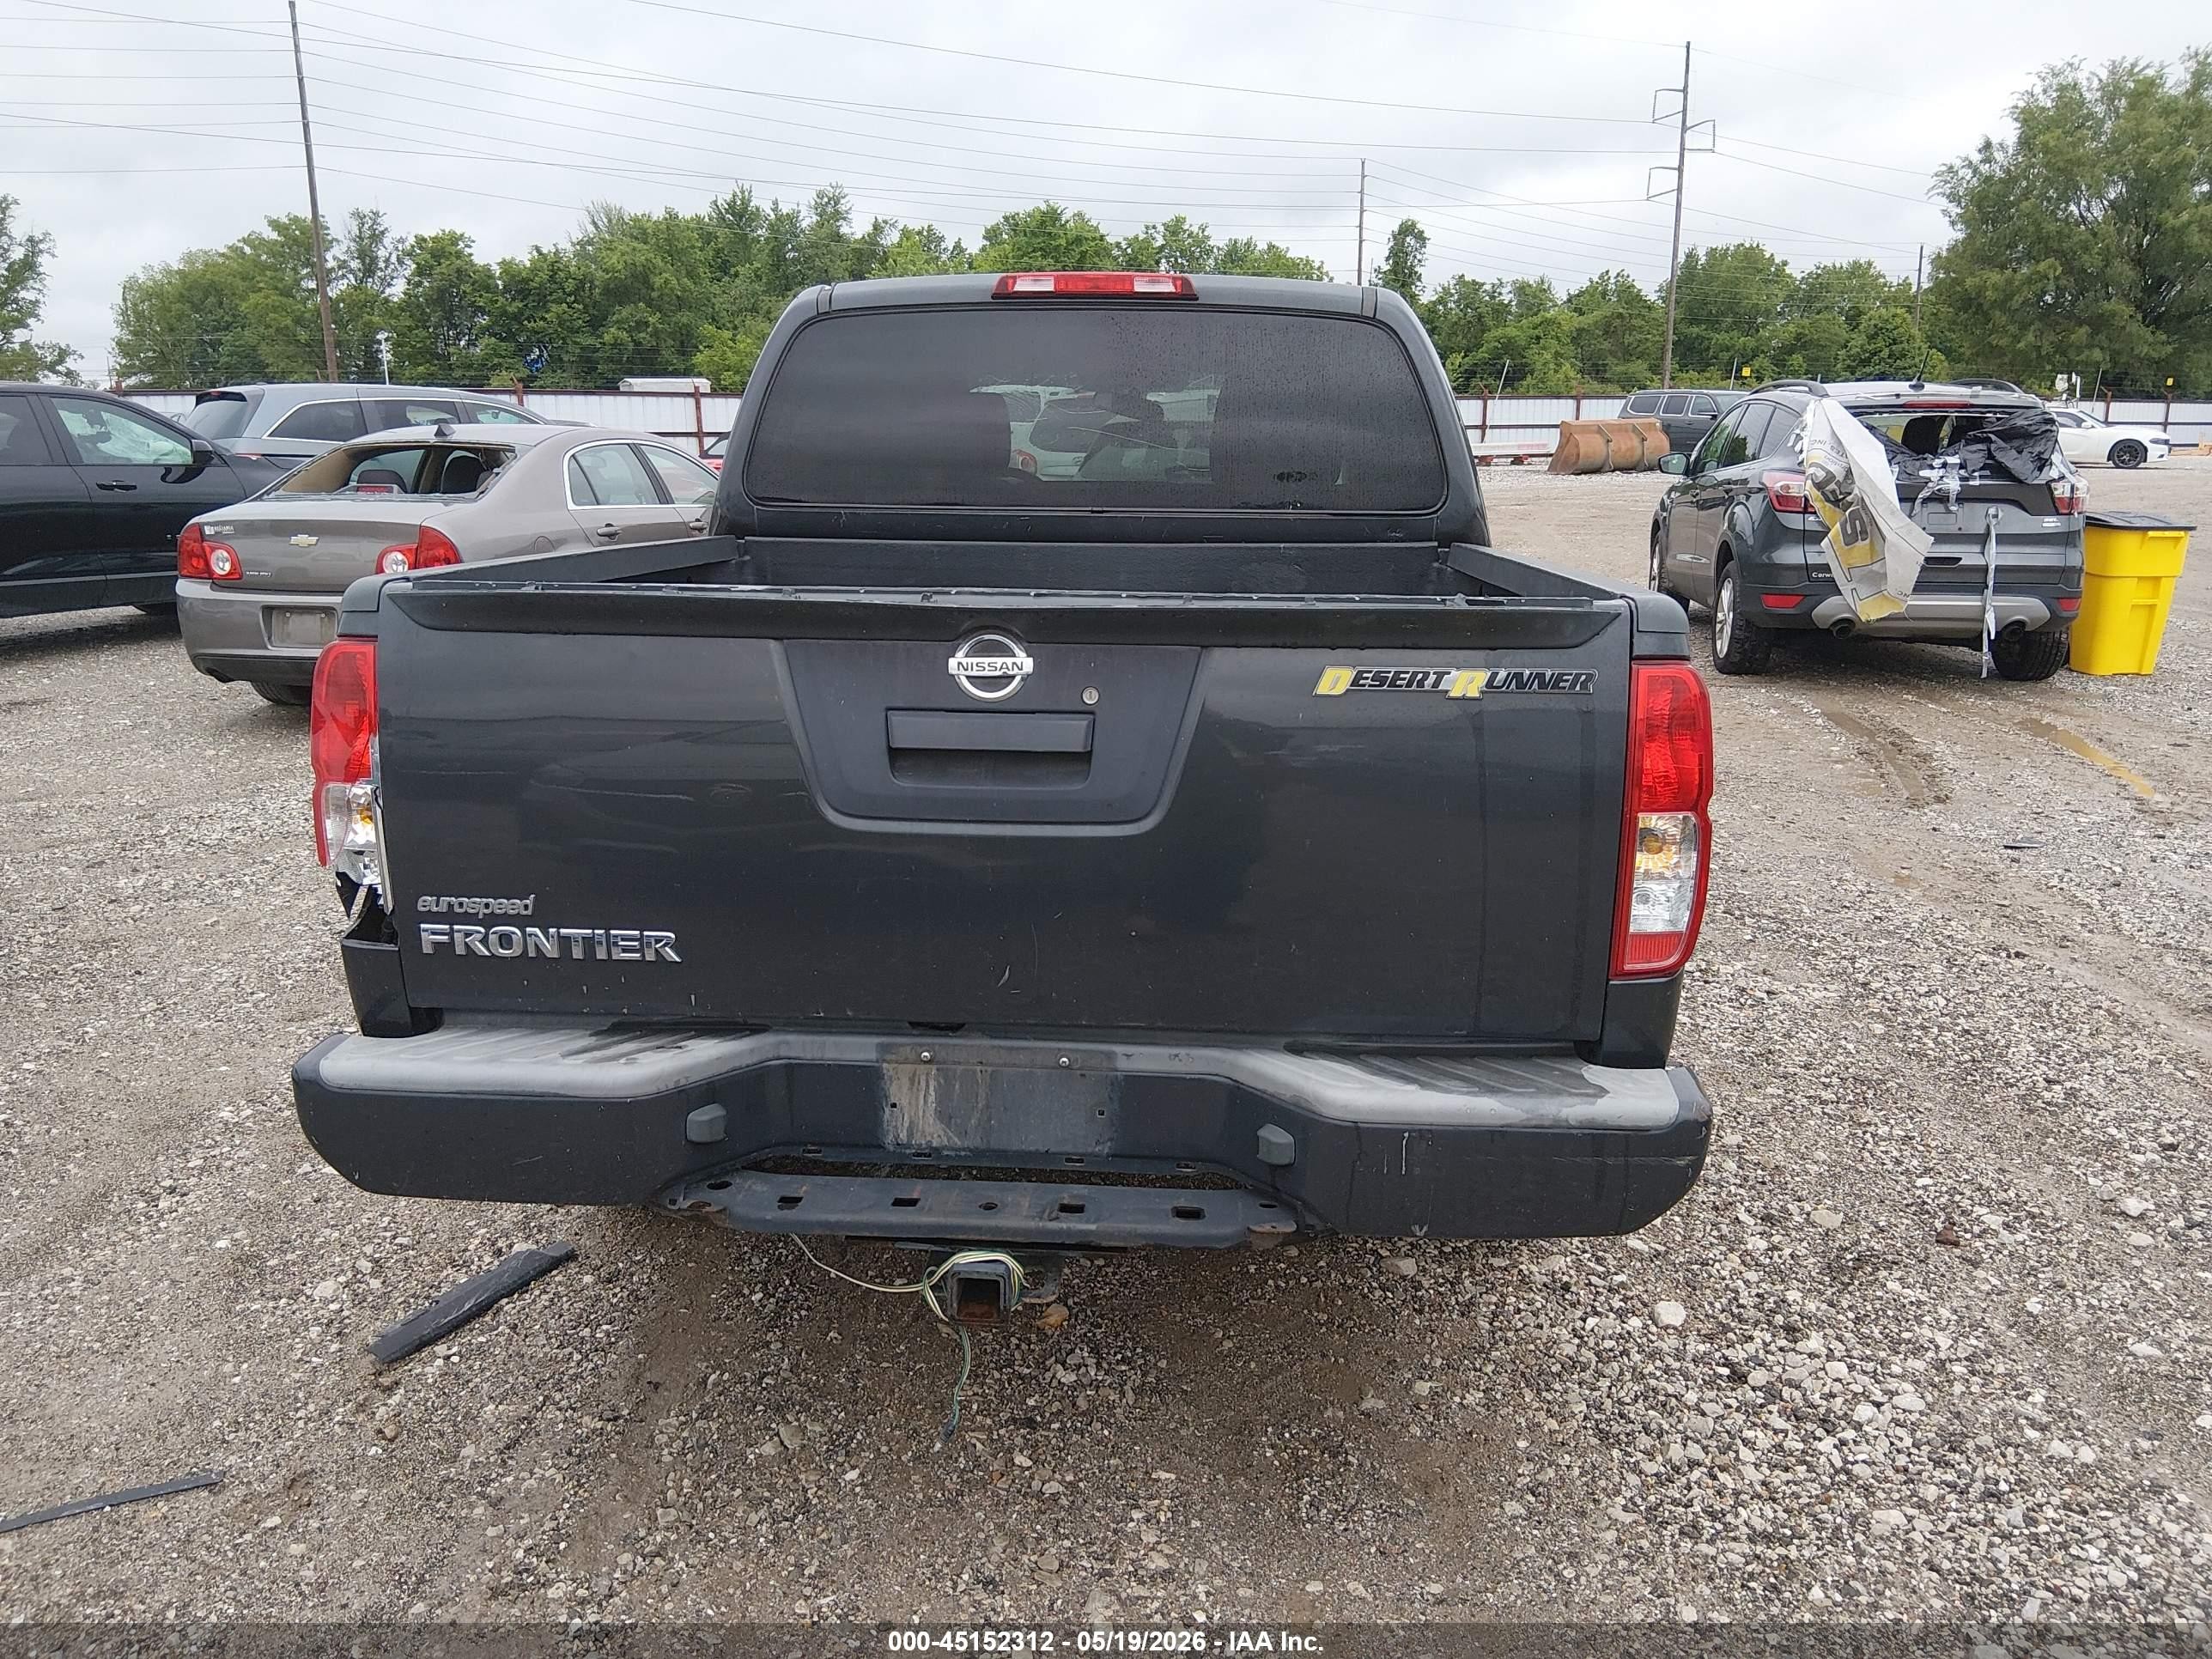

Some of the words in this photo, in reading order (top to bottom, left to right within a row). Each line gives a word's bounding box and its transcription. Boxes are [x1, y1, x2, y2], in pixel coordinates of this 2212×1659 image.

[957, 661, 1024, 672] NISSAN
[1315, 666, 1453, 696] DESERT
[1447, 668, 1596, 699] RUNNER
[417, 894, 536, 919] eurospeed
[420, 923, 683, 963] FRONTIER
